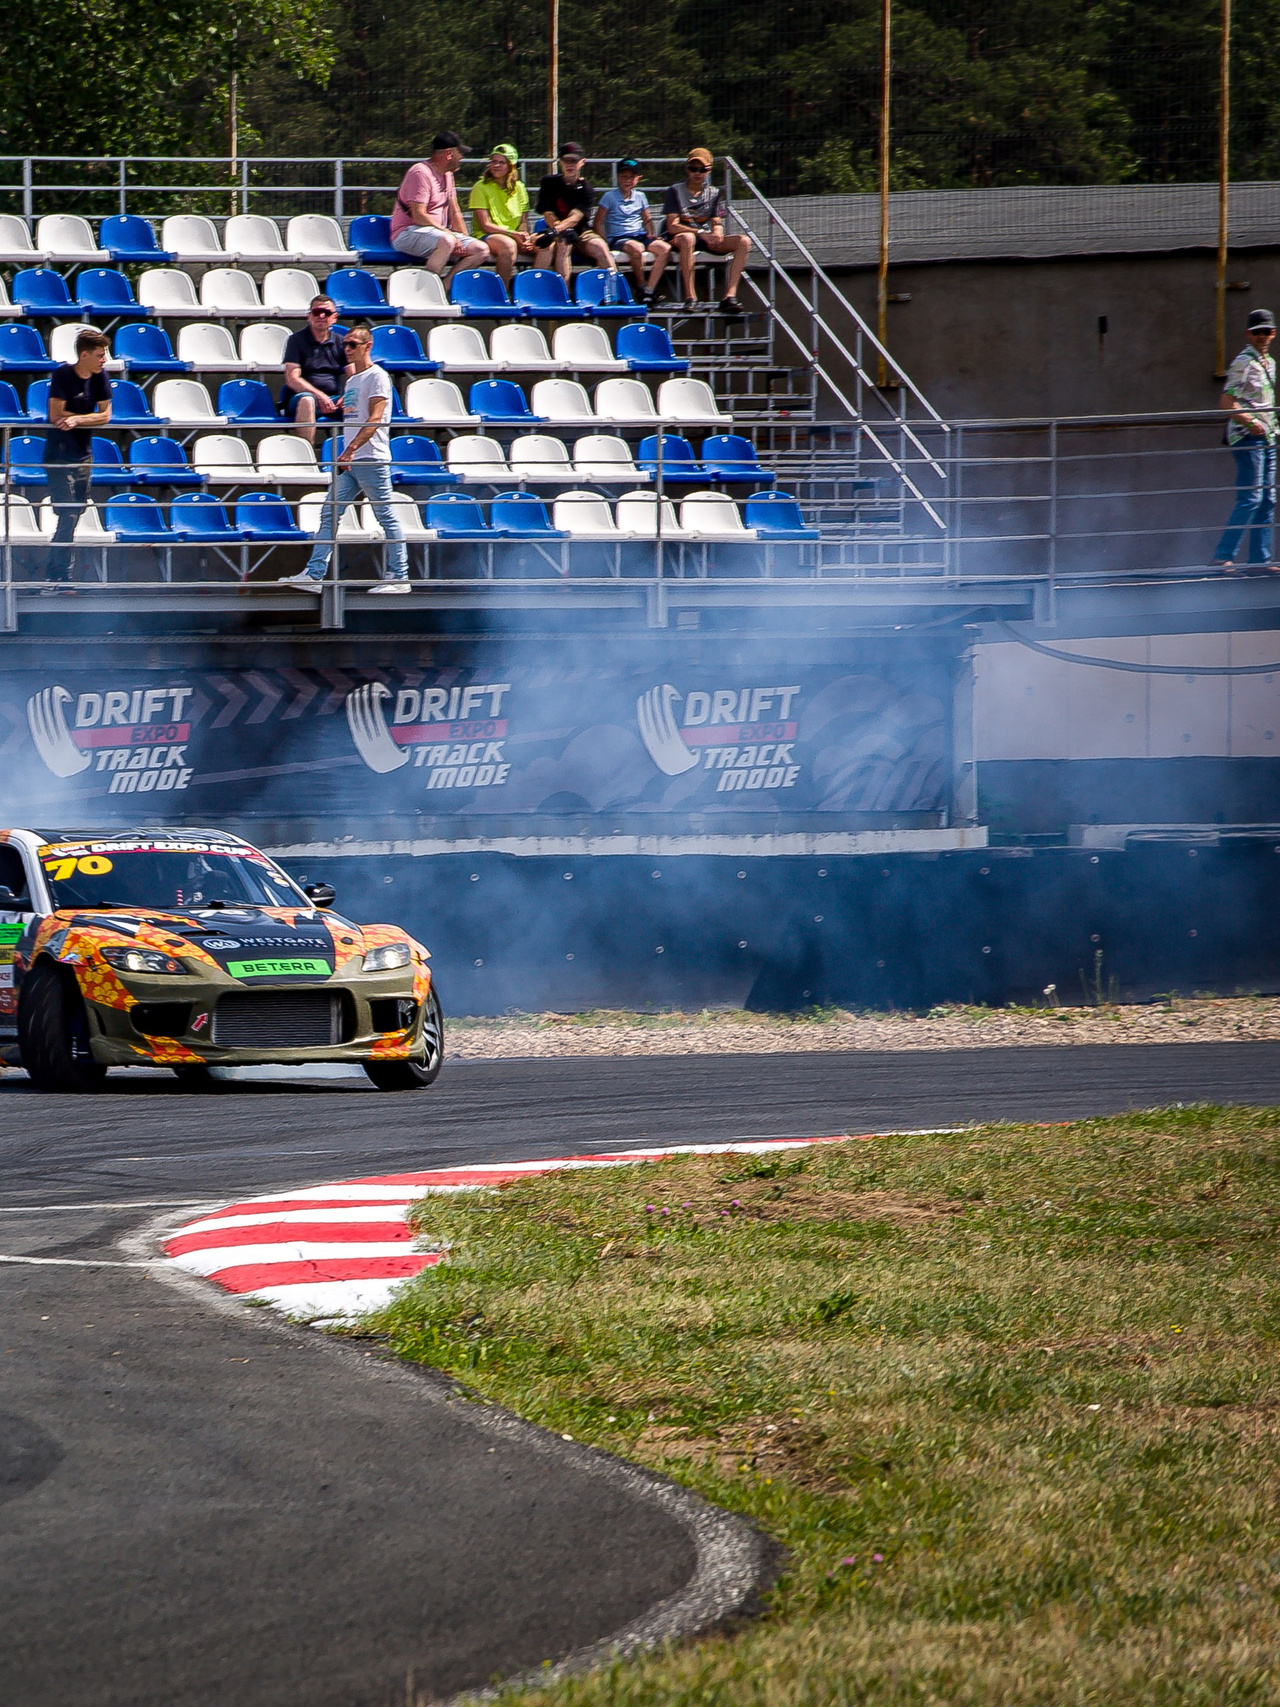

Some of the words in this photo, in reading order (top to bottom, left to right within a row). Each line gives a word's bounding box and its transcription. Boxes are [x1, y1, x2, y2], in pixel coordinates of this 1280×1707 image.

[75, 687, 194, 728] DRIFT
[394, 683, 512, 724] DRIFT
[683, 685, 802, 726] DRIFT
[130, 725, 178, 742] EXPO
[449, 722, 496, 738] EXPO
[738, 724, 786, 740] EXPO
[91, 842, 153, 852] DRIFT
[154, 841, 209, 851] EXPO
[210, 844, 252, 855] CUP
[44, 855, 113, 881] 70
[240, 937, 326, 945] WESTGATE
